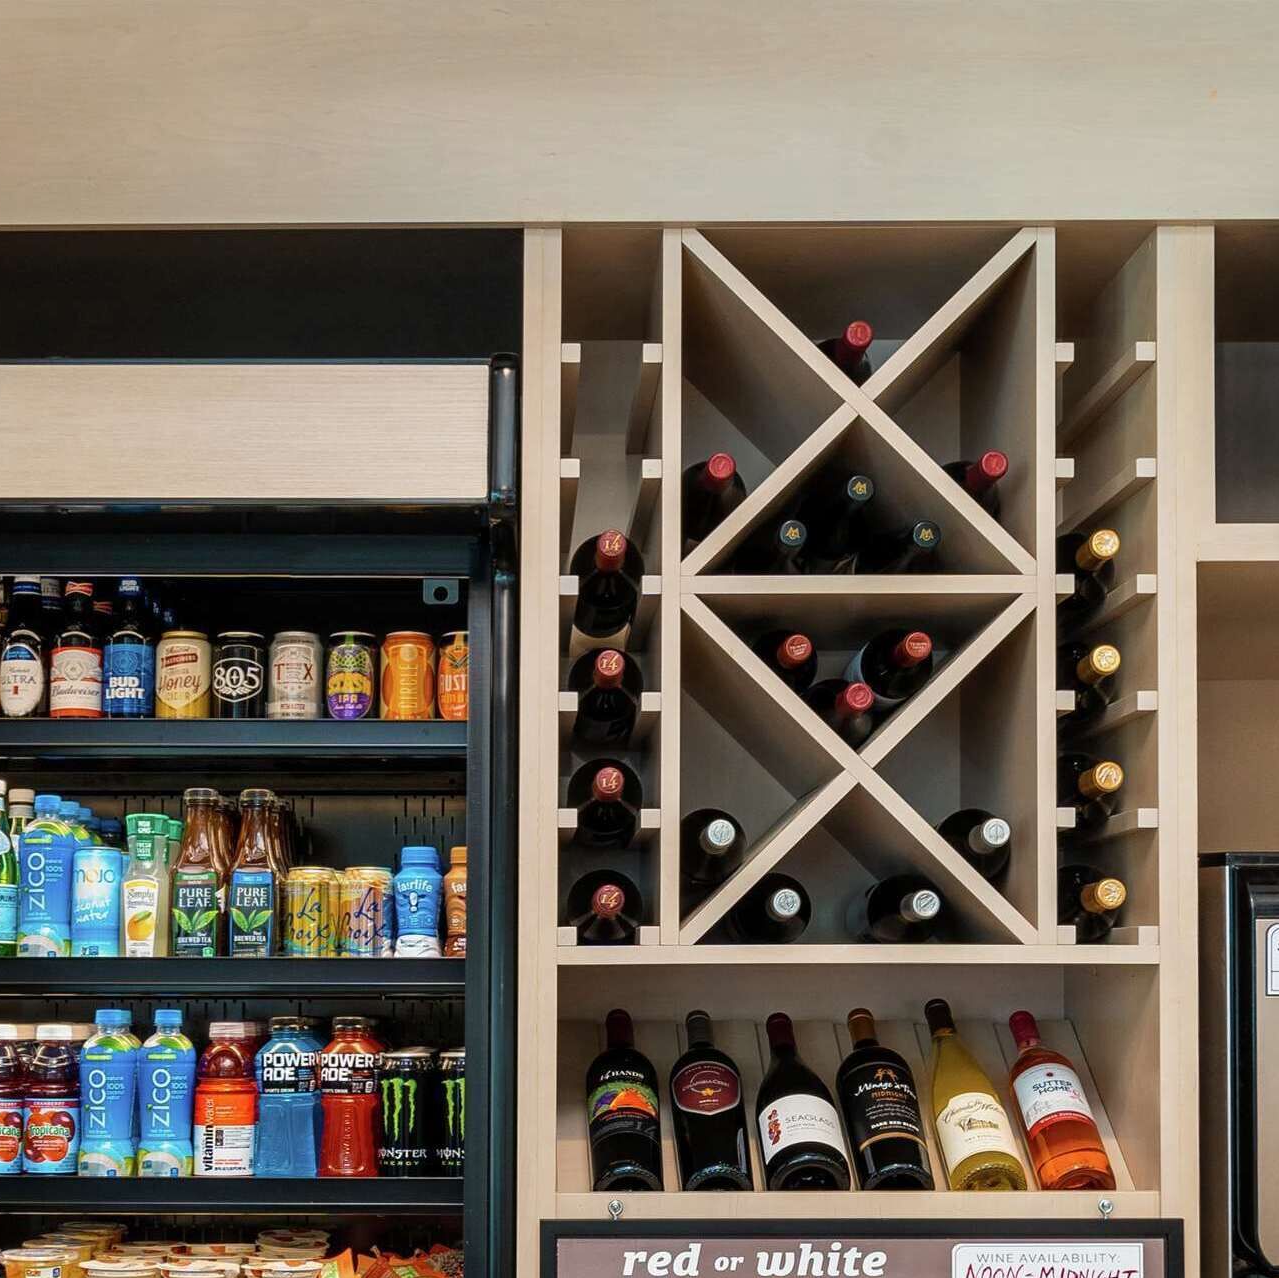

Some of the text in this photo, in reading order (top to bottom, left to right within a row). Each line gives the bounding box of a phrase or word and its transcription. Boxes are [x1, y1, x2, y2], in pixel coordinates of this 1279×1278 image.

[604, 534, 621, 551] 14
[600, 653, 619, 671] 14
[108, 676, 140, 688] BUD
[157, 674, 202, 694] Honey
[213, 666, 260, 689] 805
[50, 685, 101, 699] Budweiser
[105, 688, 145, 701] LIGHT
[601, 771, 618, 789] 14
[179, 888, 211, 898] PURE
[236, 887, 268, 898] PURE
[600, 892, 619, 907] 14
[263, 1053, 315, 1067] POWER
[321, 1053, 374, 1067] POWER
[611, 1070, 644, 1079] HANDS
[1032, 1079, 1073, 1091] SUTTER
[1038, 1086, 1069, 1096] HOME
[30, 1125, 70, 1138] Tropicana
[622, 1243, 888, 1277] red or white
[976, 1253, 1120, 1263] WINE AVAILABILITY:
